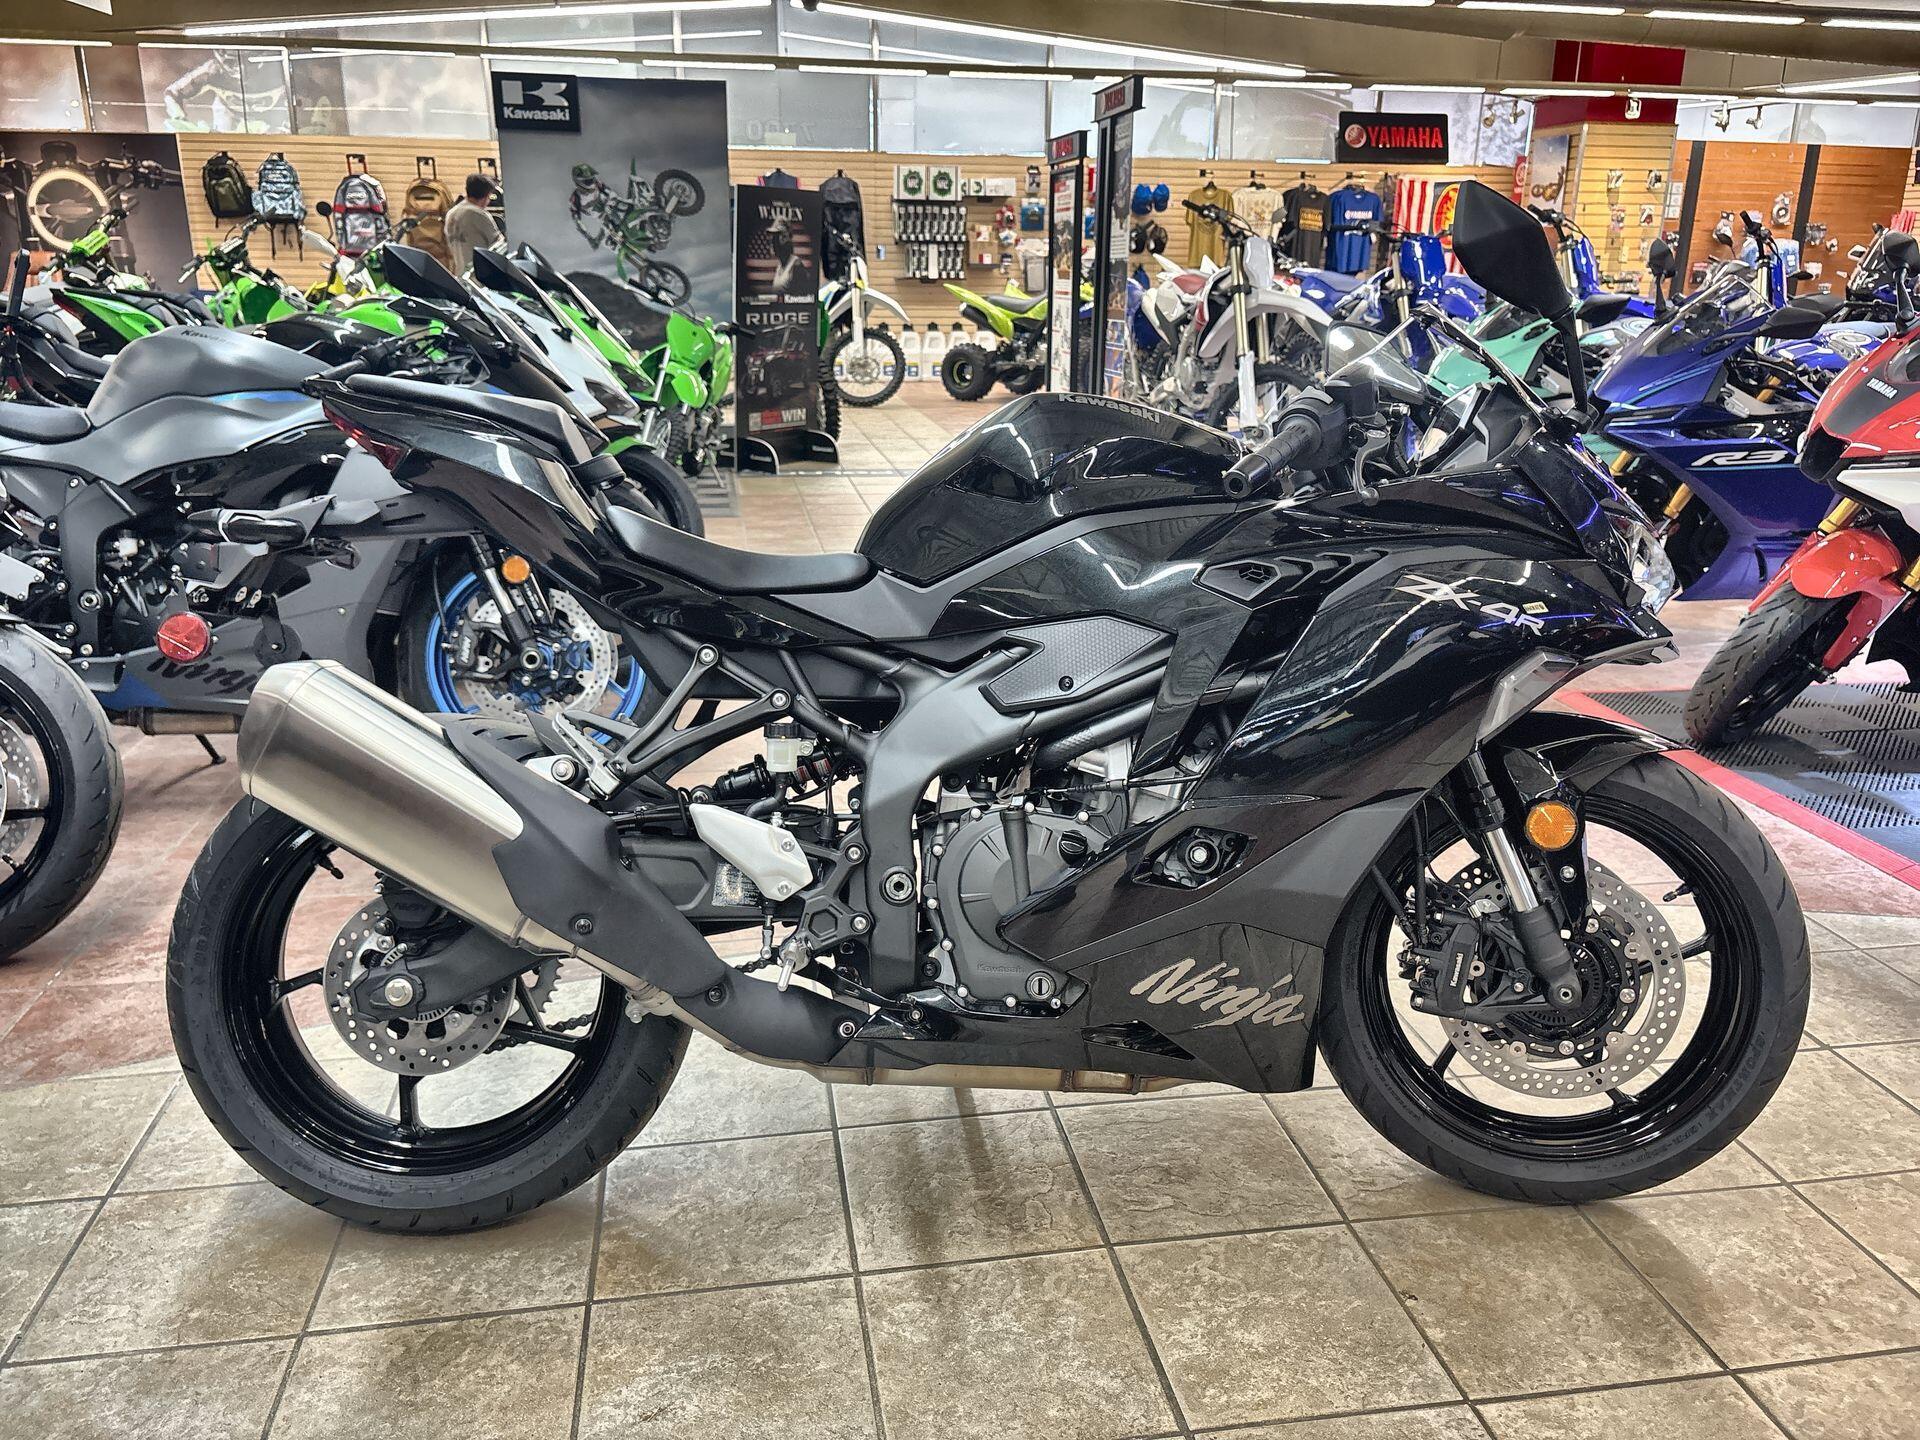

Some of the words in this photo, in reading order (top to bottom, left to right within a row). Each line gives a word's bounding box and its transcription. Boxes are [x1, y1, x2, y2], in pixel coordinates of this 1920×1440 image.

[502, 106, 570, 121] Kawasaki
[1367, 126, 1444, 148] YAMAHA
[746, 312, 811, 326] RIDGE
[1866, 377, 1898, 400] YAMAHA
[781, 408, 806, 422] WIN
[1059, 393, 1160, 424] Kawasaki
[1691, 450, 1788, 467] R3
[1449, 952, 1464, 988] Kawasaki
[1129, 957, 1305, 1030] Ninja
